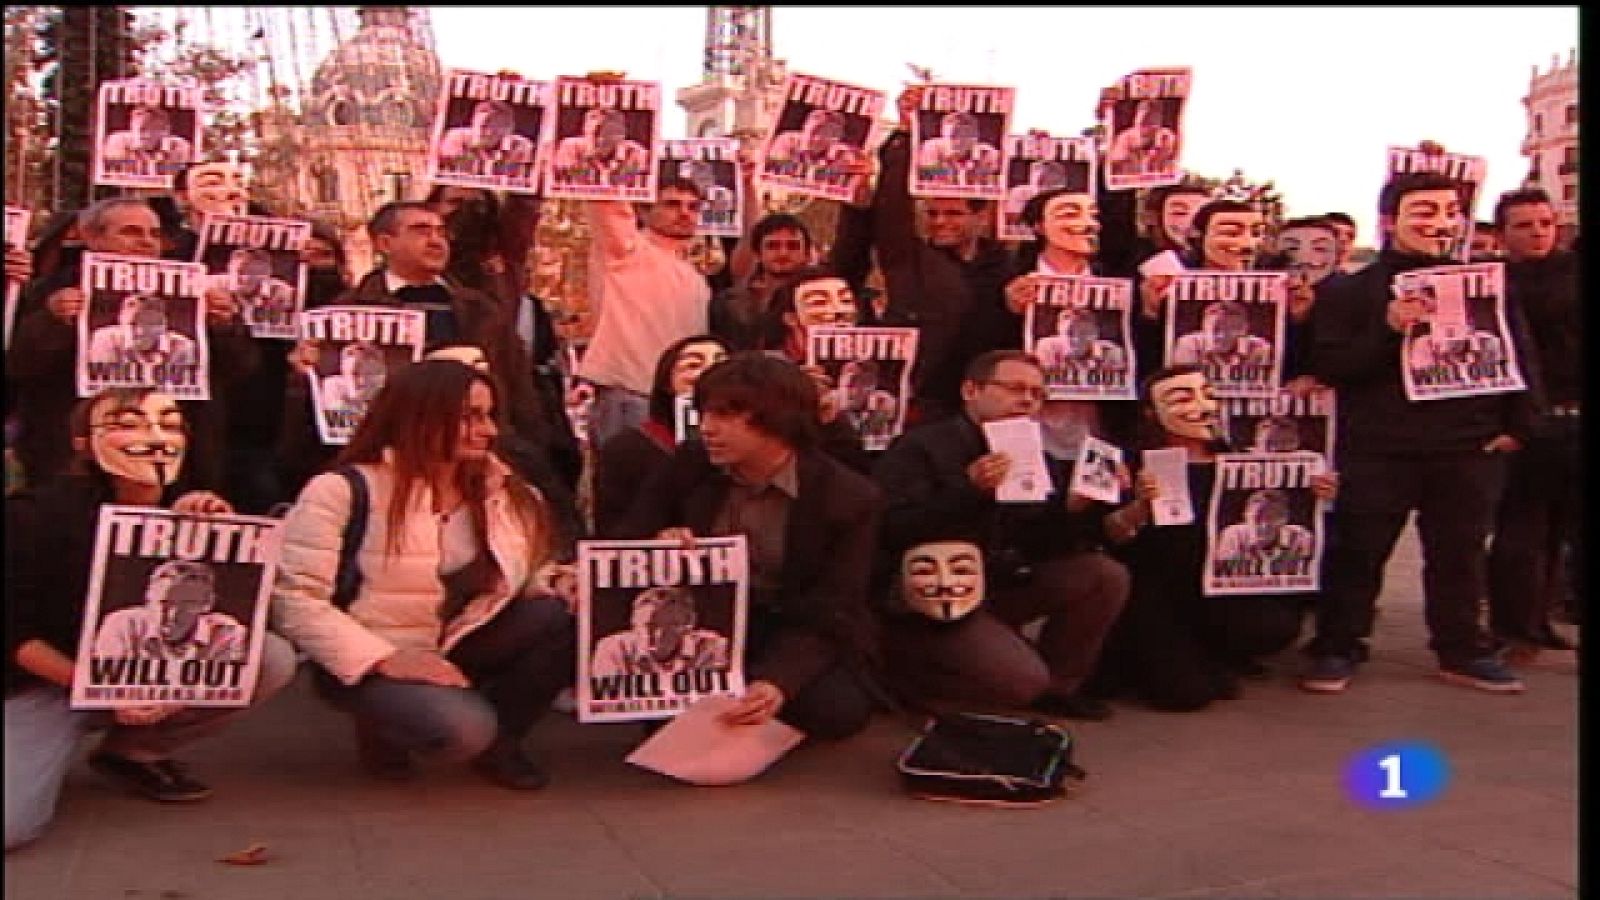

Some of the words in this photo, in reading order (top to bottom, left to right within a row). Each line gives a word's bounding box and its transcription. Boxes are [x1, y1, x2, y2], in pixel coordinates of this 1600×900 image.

[102, 84, 199, 108] TRUTH
[450, 73, 546, 107] TRUTH
[557, 82, 655, 110] TRUTH
[789, 79, 883, 116] TRUTH
[918, 87, 1009, 113] TRUTH
[206, 221, 309, 250] TRUTH
[90, 261, 203, 297] TRUTH
[1174, 275, 1282, 301] TRUTH
[1036, 280, 1127, 310] TRUTH
[307, 313, 420, 345] TRUTH
[815, 334, 908, 360] TRUTH
[87, 361, 145, 383] WILL
[1411, 367, 1463, 387] WILL
[1223, 461, 1322, 488] TRUTH
[110, 518, 273, 563] TRUTH
[589, 547, 737, 588] TRUTH
[1213, 559, 1262, 577] WILL
[1269, 558, 1313, 577] OUT
[90, 658, 170, 686] WILL
[179, 659, 248, 688] OUT
[590, 674, 664, 701] WILL
[672, 668, 733, 694] OUT
